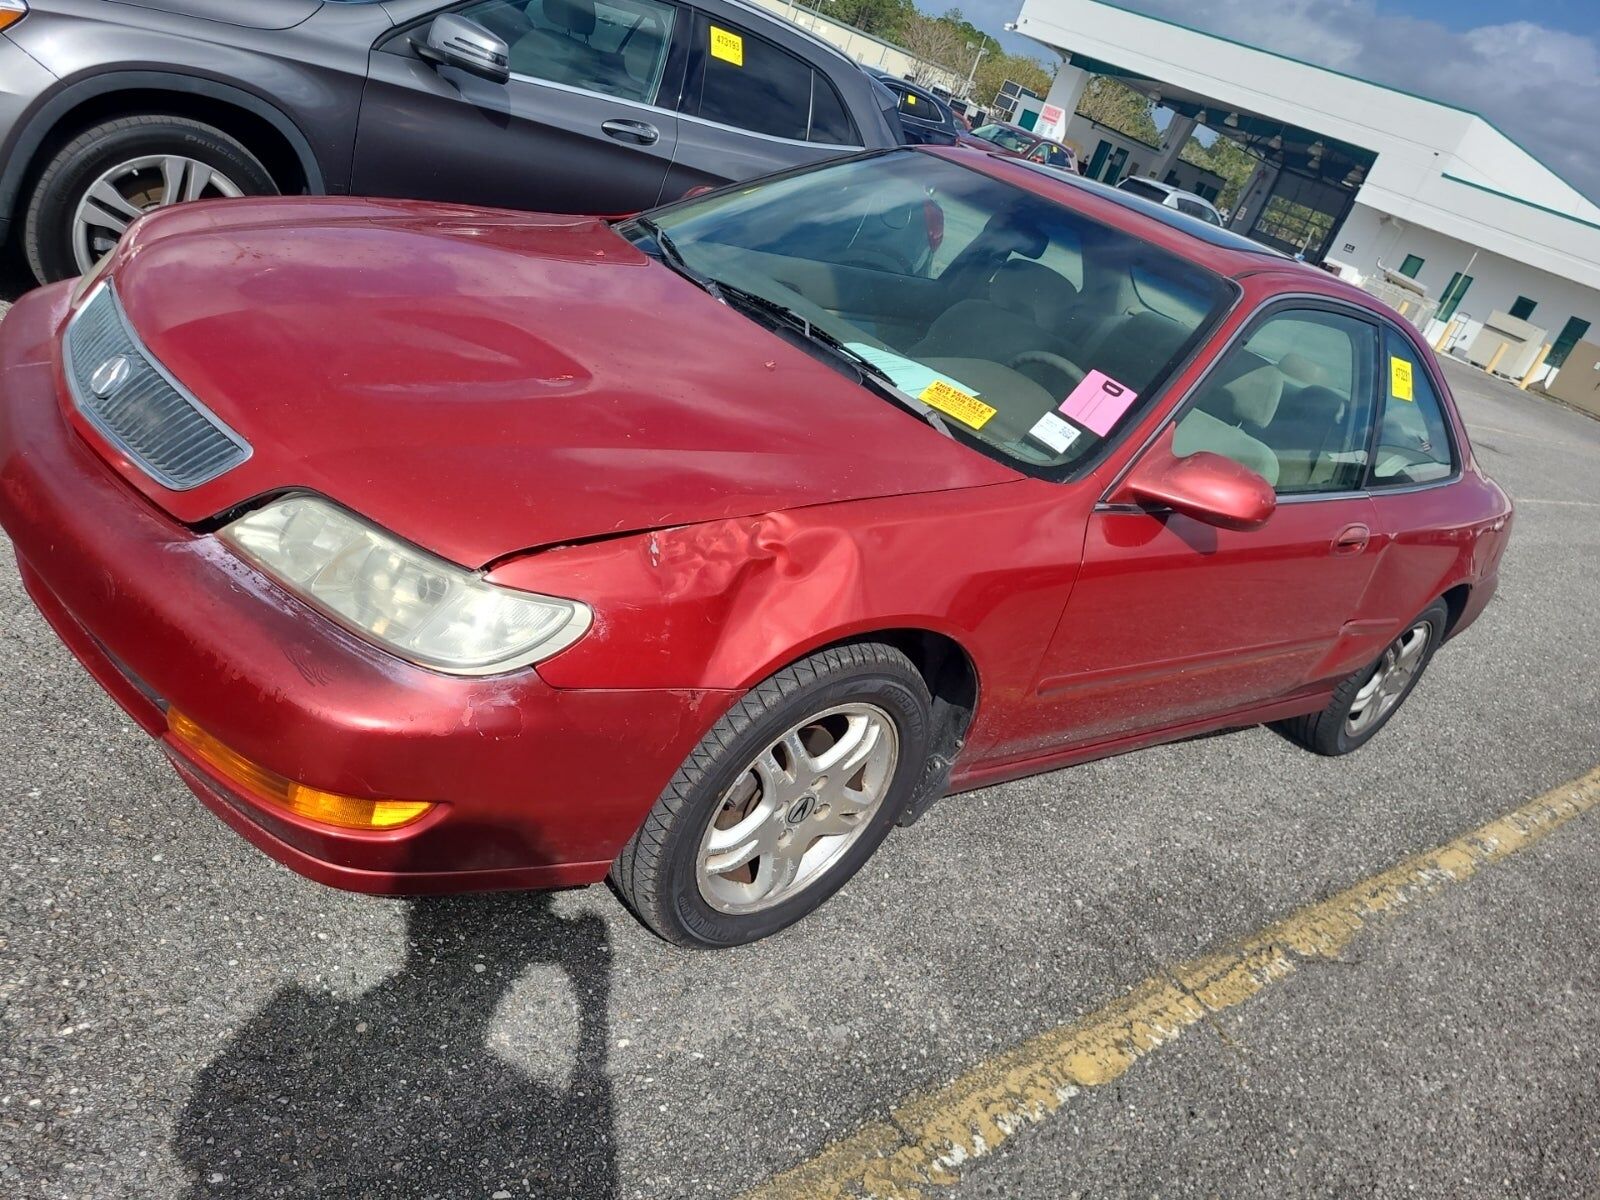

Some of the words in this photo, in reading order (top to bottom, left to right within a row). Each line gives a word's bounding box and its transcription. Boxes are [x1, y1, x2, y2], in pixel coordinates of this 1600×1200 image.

[934, 386, 950, 396] NOT
[951, 394, 966, 404] FOR
[966, 403, 985, 414] SALE
[935, 381, 951, 392] THIS
[953, 390, 983, 408] VEHICLE
